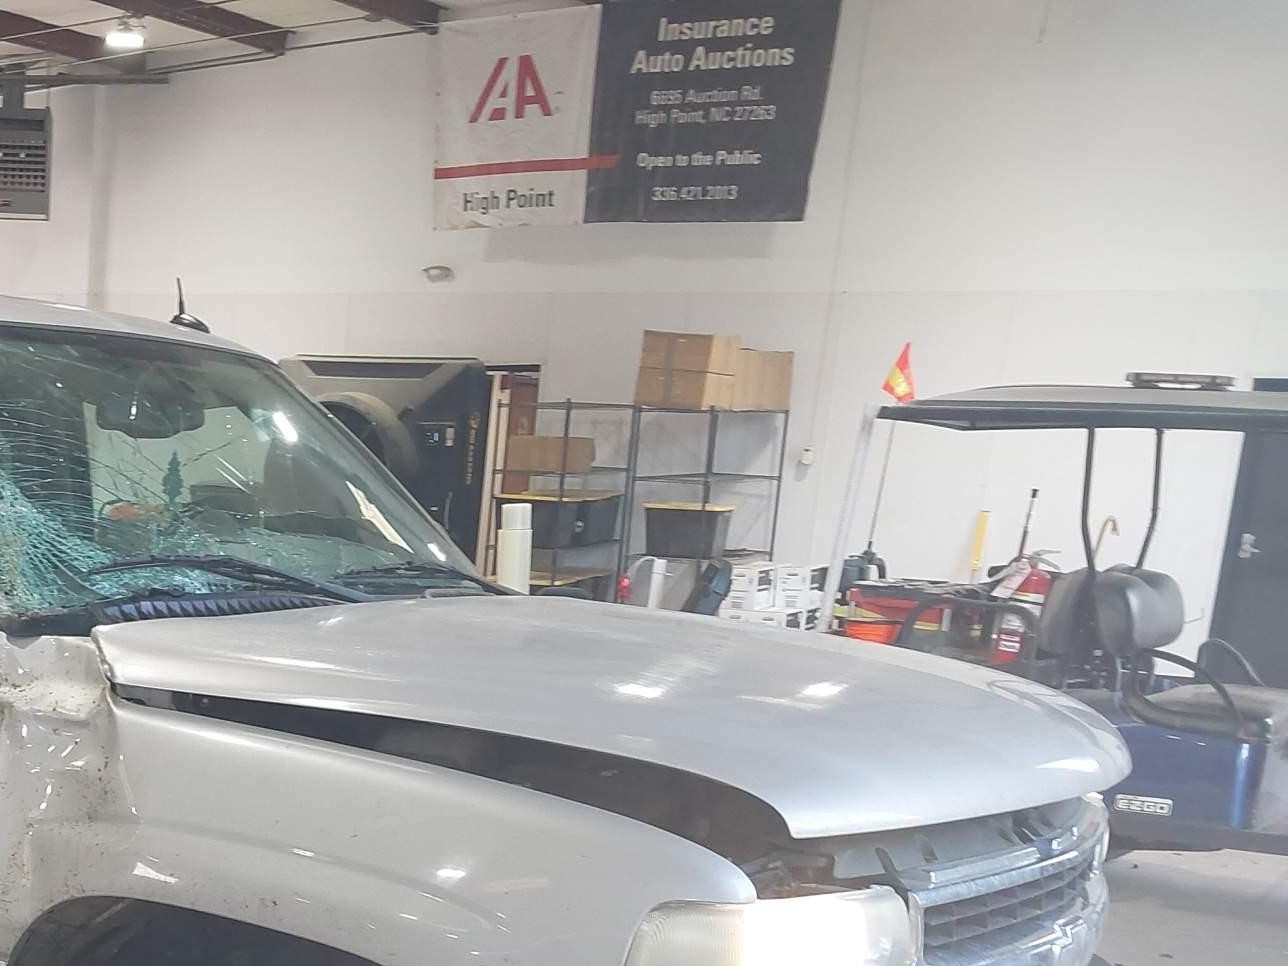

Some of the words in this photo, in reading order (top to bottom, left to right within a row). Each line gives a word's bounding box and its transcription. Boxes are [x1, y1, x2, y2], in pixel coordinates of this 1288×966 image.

[657, 16, 775, 41] Insurance
[629, 49, 685, 74] Auto
[687, 43, 795, 71] Auctions
[684, 87, 739, 103] Auction
[634, 109, 668, 128] High
[708, 106, 732, 122] NC
[636, 153, 674, 171] Open
[675, 154, 689, 167] to
[691, 152, 713, 166] the
[715, 150, 762, 165] Public
[463, 189, 500, 215] High
[505, 187, 555, 209] Point
